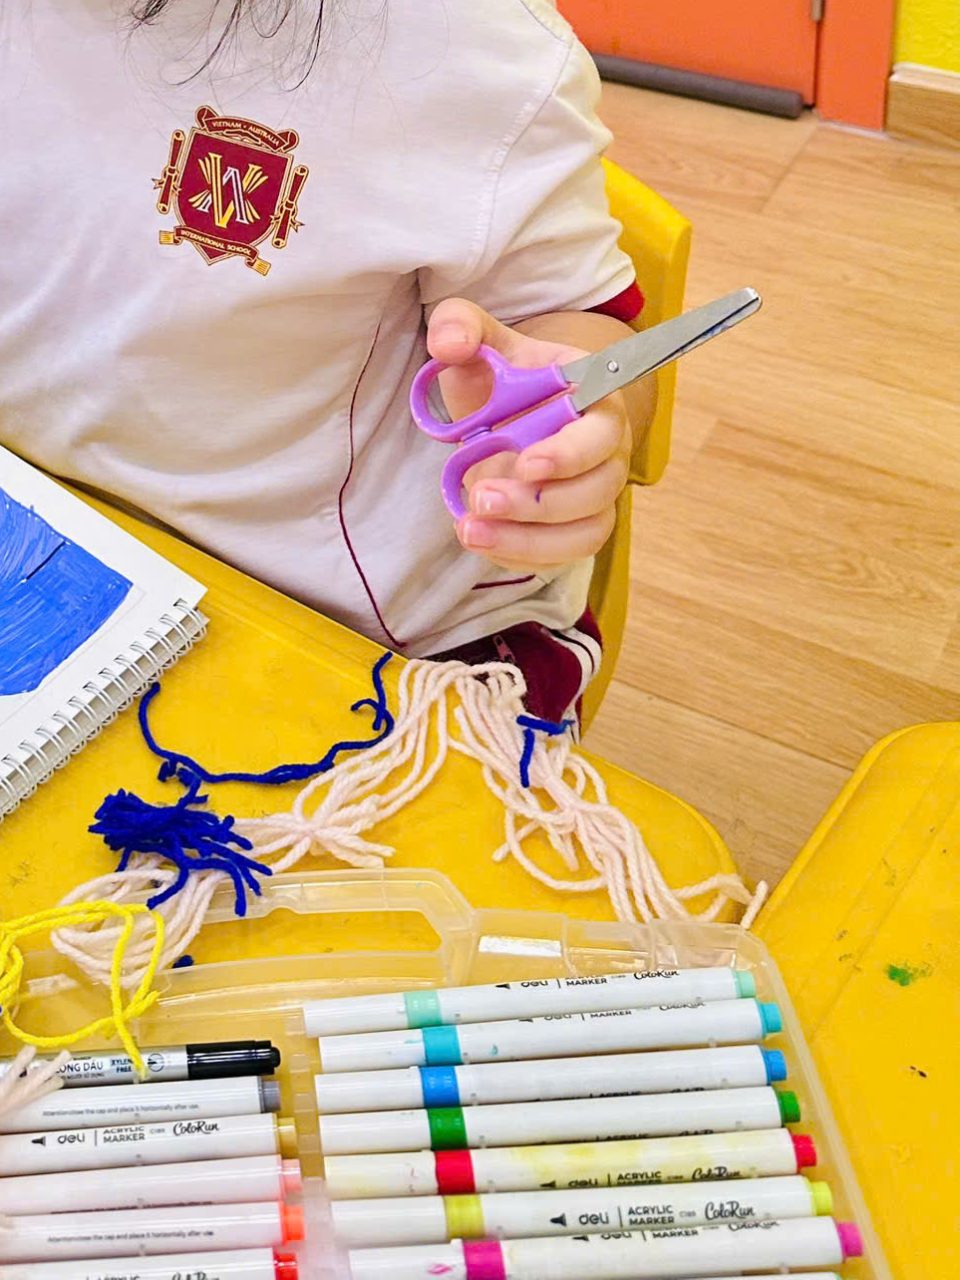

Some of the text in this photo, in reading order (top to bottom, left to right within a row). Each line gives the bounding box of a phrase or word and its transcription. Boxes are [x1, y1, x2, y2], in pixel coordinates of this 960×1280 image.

[180, 229, 253, 256] INTERNATIONAL SCHOOL
[566, 978, 608, 987] MARKER
[57, 1133, 85, 1144] deli
[173, 1121, 219, 1136] ColoRun
[103, 1126, 144, 1134] ACRYLIC
[103, 1133, 145, 1143] MARKER
[617, 1171, 661, 1181] ACRYLIC
[578, 1212, 609, 1225] deli
[704, 1200, 755, 1221] ColoRun
[628, 1205, 673, 1216] ACRYLIC
[629, 1216, 674, 1226] MARKER
[653, 1229, 699, 1239] MARKER
